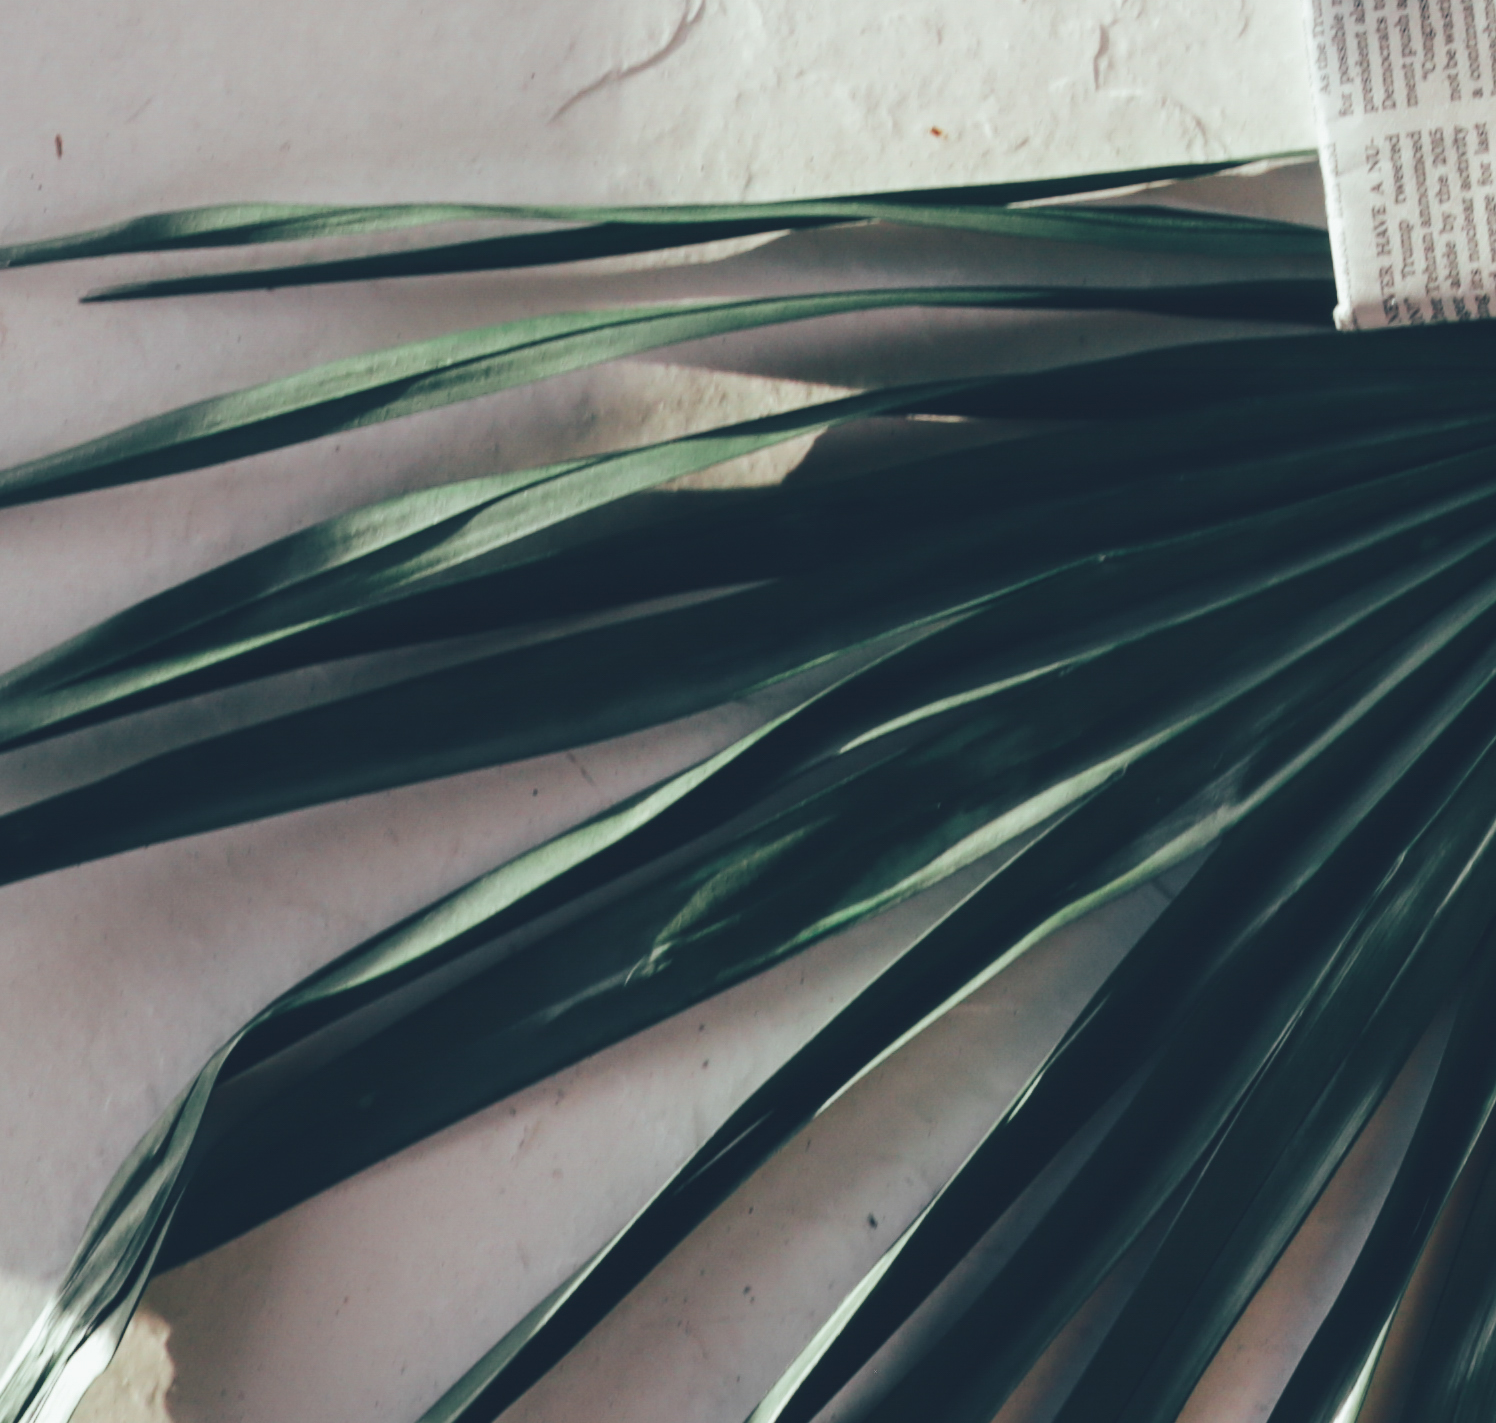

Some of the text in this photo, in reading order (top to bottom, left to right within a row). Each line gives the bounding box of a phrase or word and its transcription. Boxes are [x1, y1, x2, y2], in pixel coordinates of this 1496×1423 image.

[1393, 13, 1417, 58] push
[1375, 16, 1397, 111] Democrats
[1401, 61, 1419, 107] ment
[1446, 72, 1461, 102] not
[1384, 133, 1416, 280] Trump tweeted
